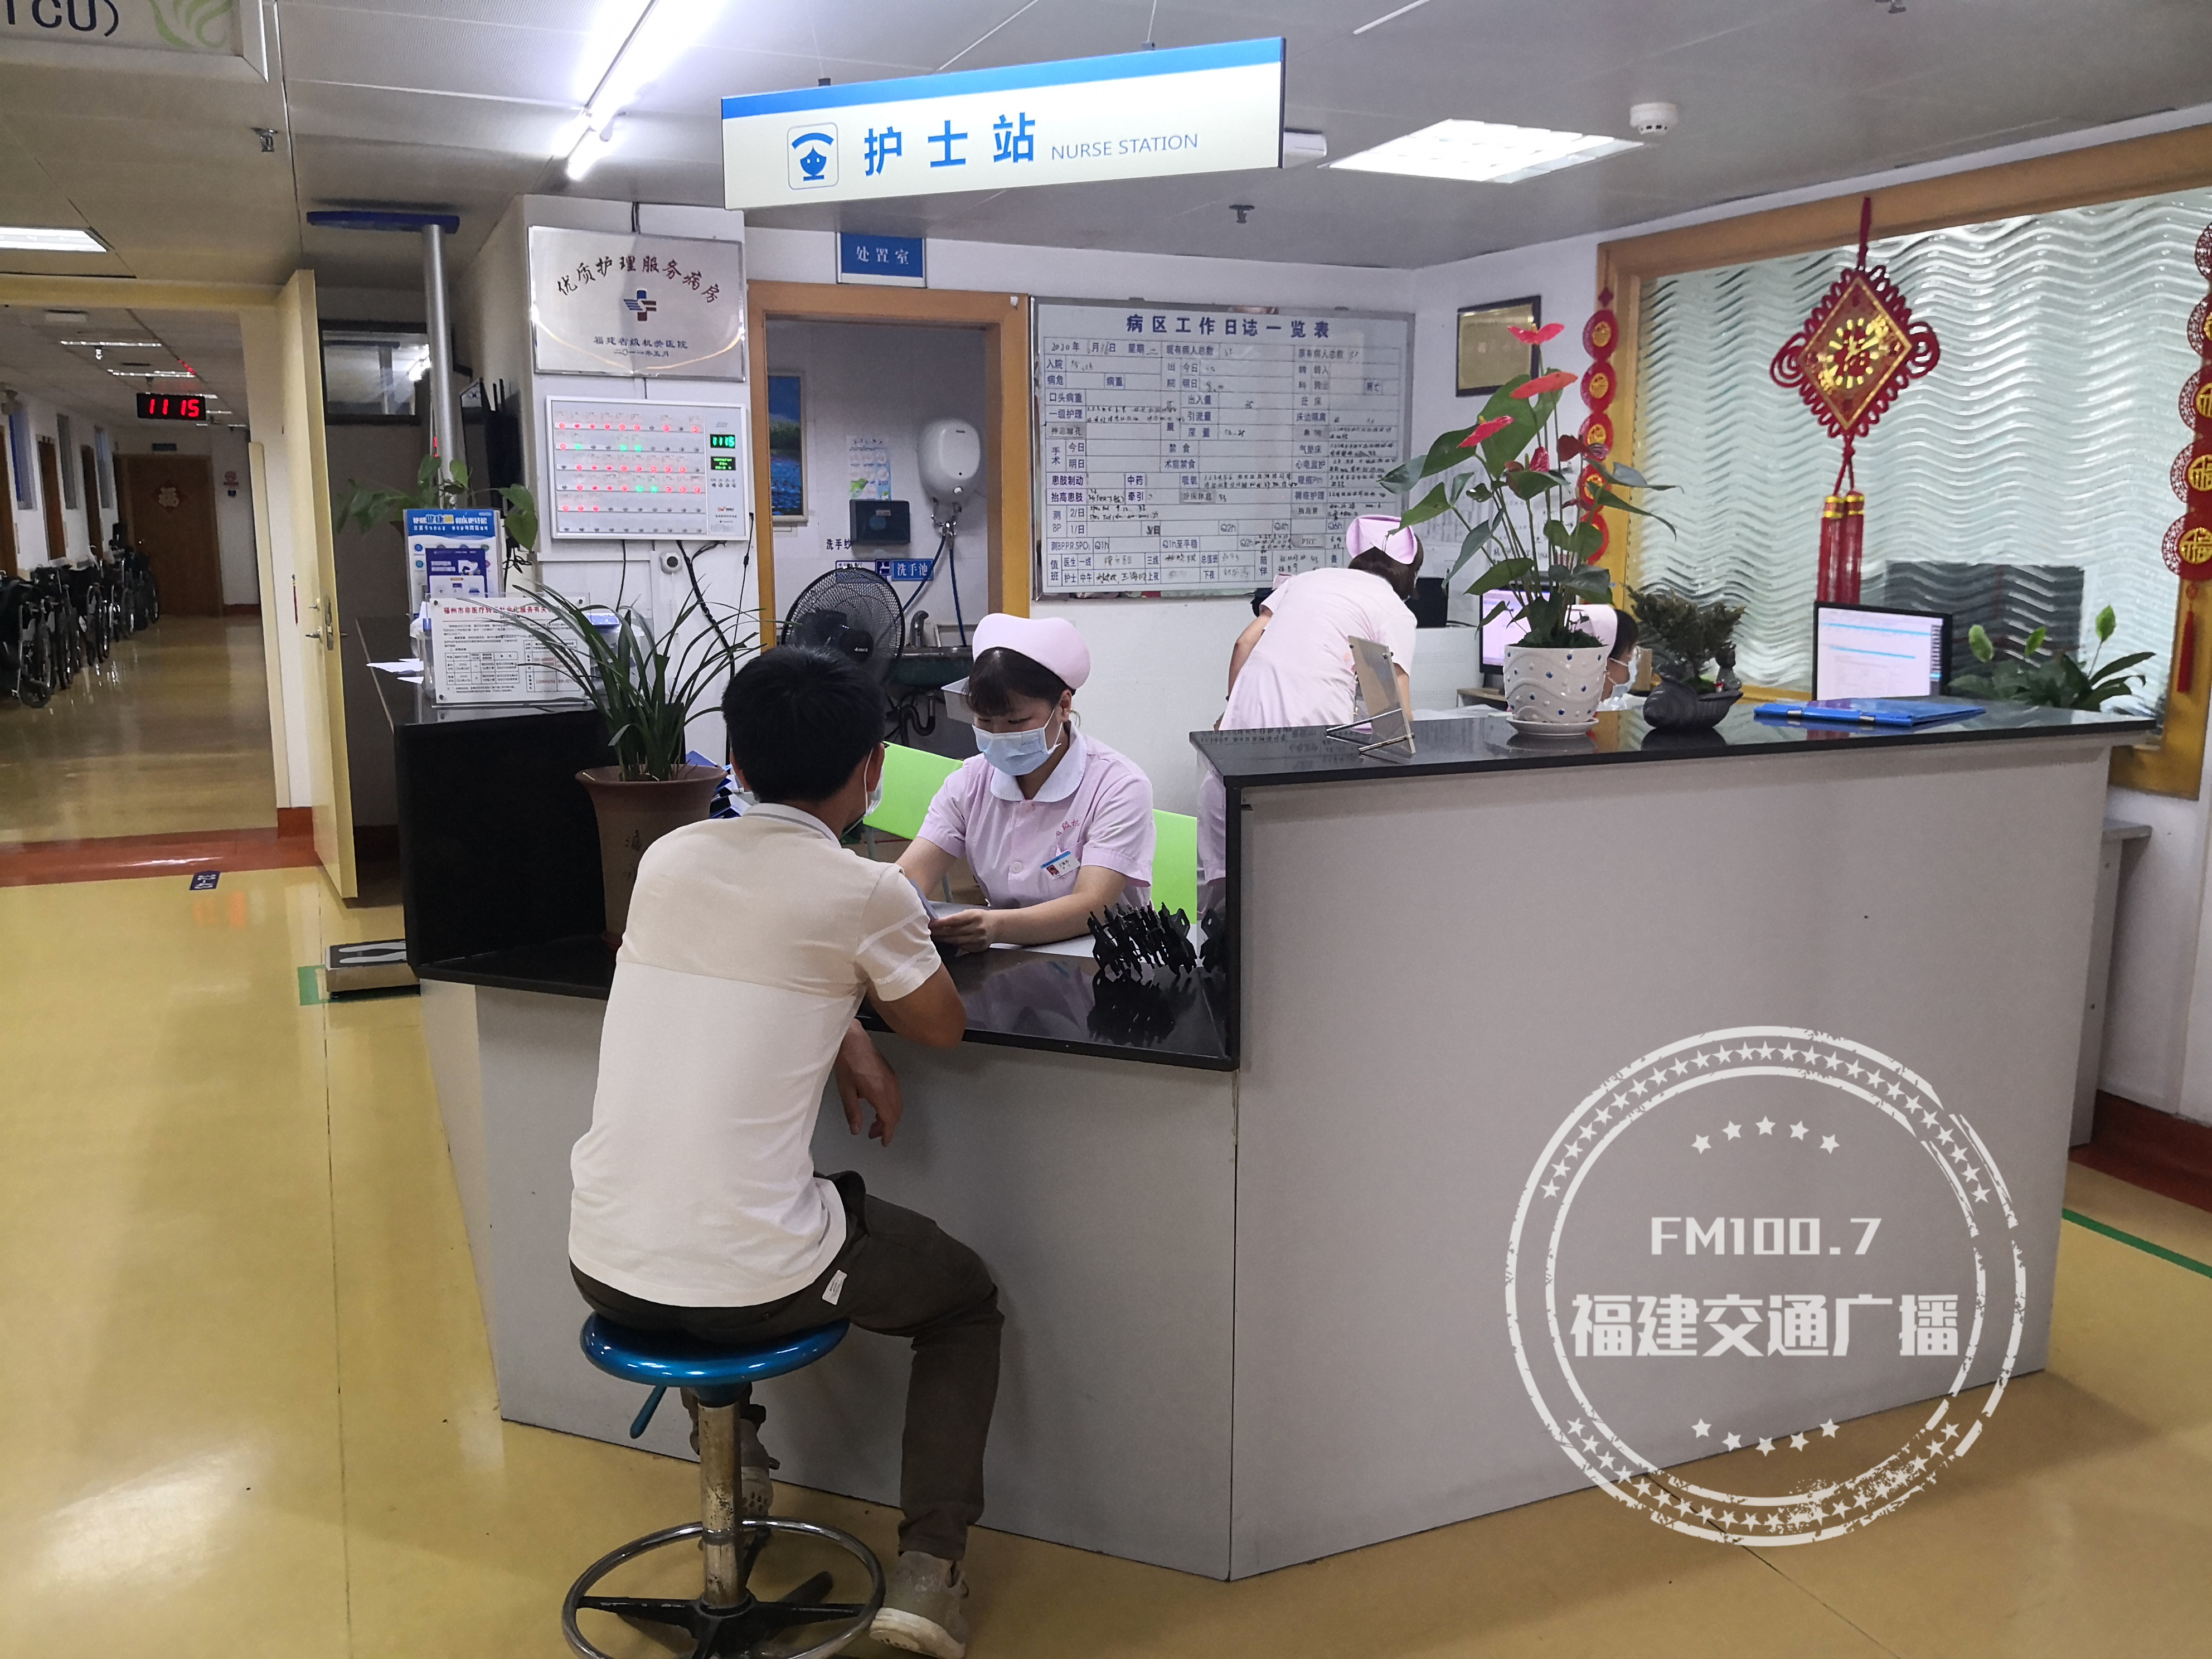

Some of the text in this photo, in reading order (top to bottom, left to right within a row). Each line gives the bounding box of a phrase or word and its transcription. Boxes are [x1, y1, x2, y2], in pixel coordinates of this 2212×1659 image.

[864, 111, 1036, 176] 护士站
[1051, 133, 1199, 161] NURSE STATION
[856, 245, 909, 265] 处置室
[557, 255, 720, 303] 优质护理服务病房
[1182, 362, 1198, 373] 今日
[1049, 392, 1083, 403] 口头病重
[1049, 409, 1083, 419] 一级护理
[1068, 442, 1085, 453] 今日
[1068, 458, 1085, 469] 明日
[1051, 475, 1084, 486] 患肢制动
[1127, 475, 1143, 486] 中药
[1051, 492, 1084, 502] 抬高患肢
[1128, 491, 1144, 502] 牵引
[1064, 557, 1076, 567] 医生
[897, 562, 928, 577] 洗手池
[1064, 573, 1077, 583] 护士
[1079, 573, 1093, 583] 中午
[1147, 571, 1160, 581] 上夜
